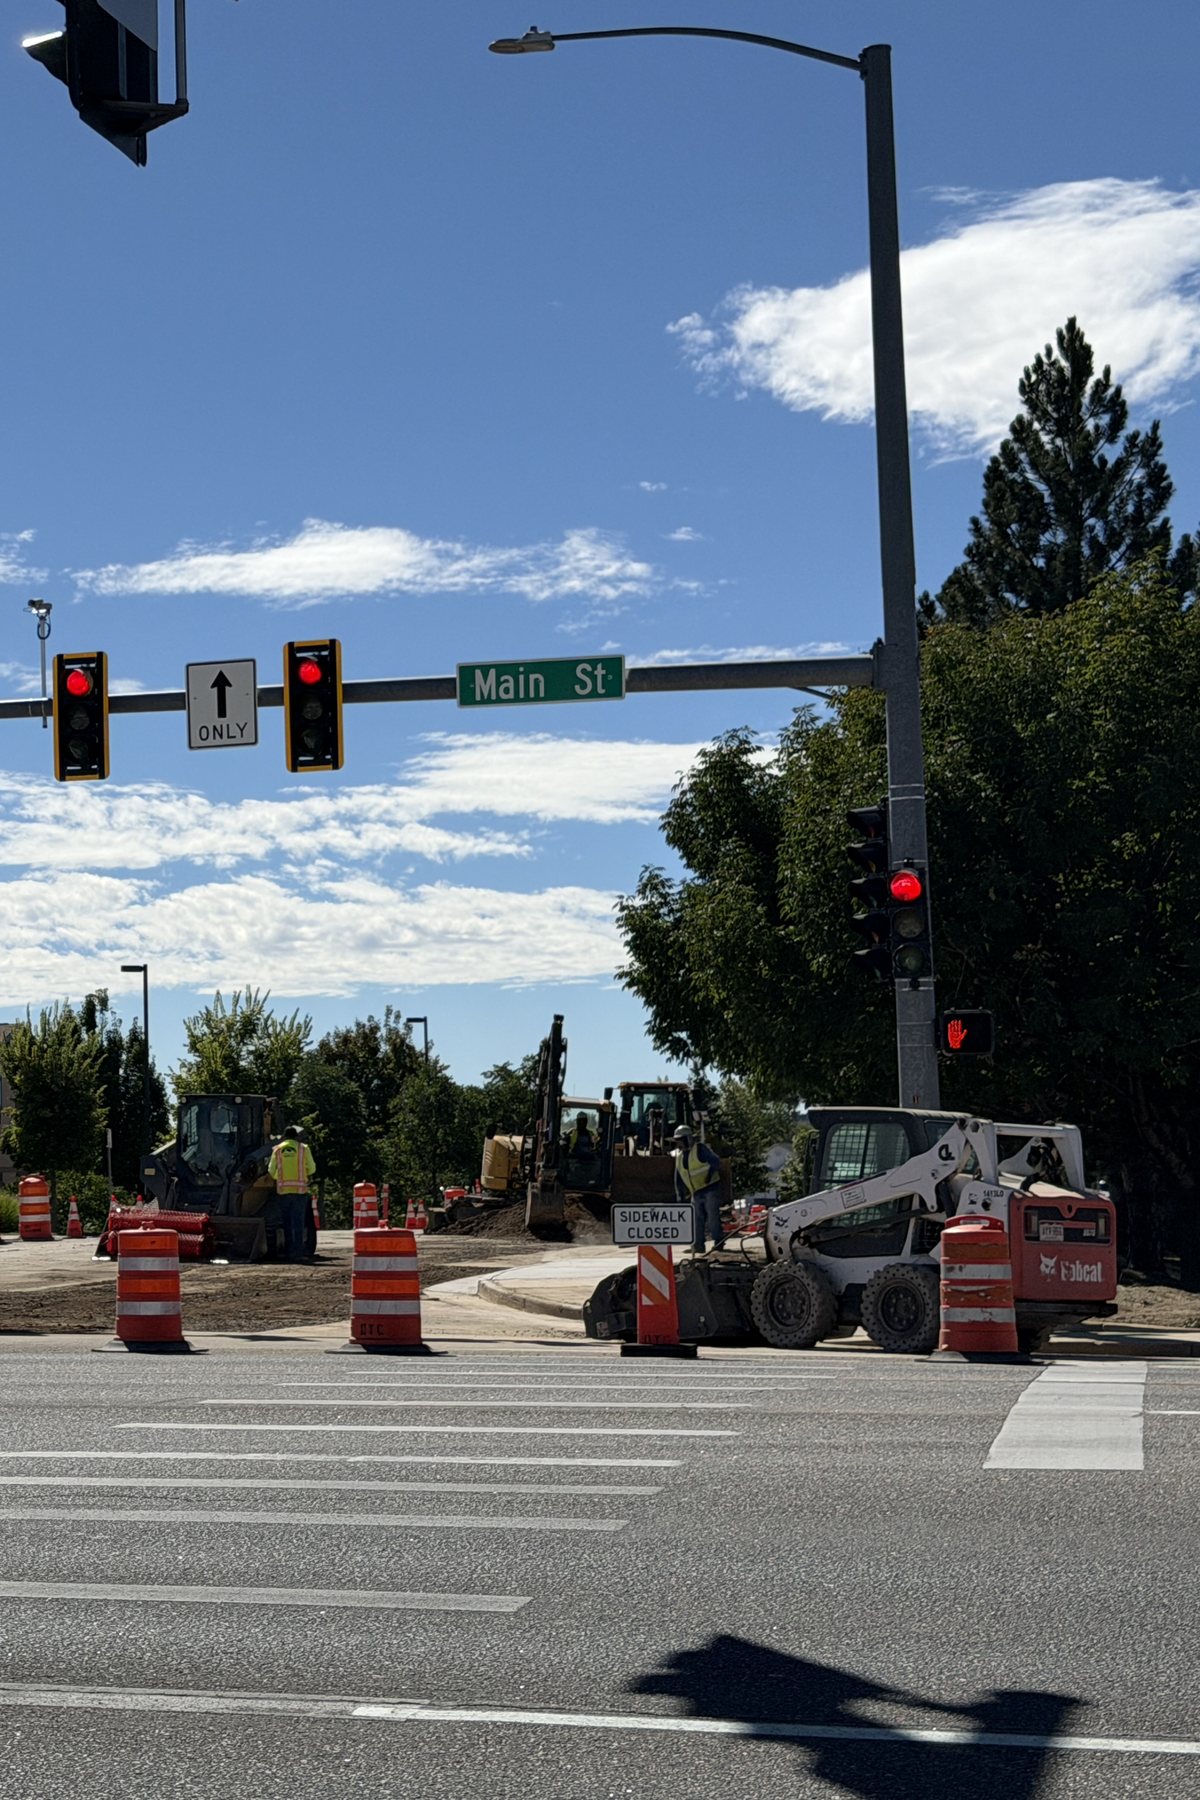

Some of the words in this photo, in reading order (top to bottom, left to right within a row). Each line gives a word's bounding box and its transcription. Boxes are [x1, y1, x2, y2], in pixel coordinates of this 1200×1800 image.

[474, 666, 545, 701] Main
[574, 662, 606, 696] St
[198, 721, 249, 742] ONLY
[620, 1210, 686, 1223] SIDEWALK
[627, 1227, 679, 1239] CLOSED
[1060, 1260, 1103, 1284] Bobcat
